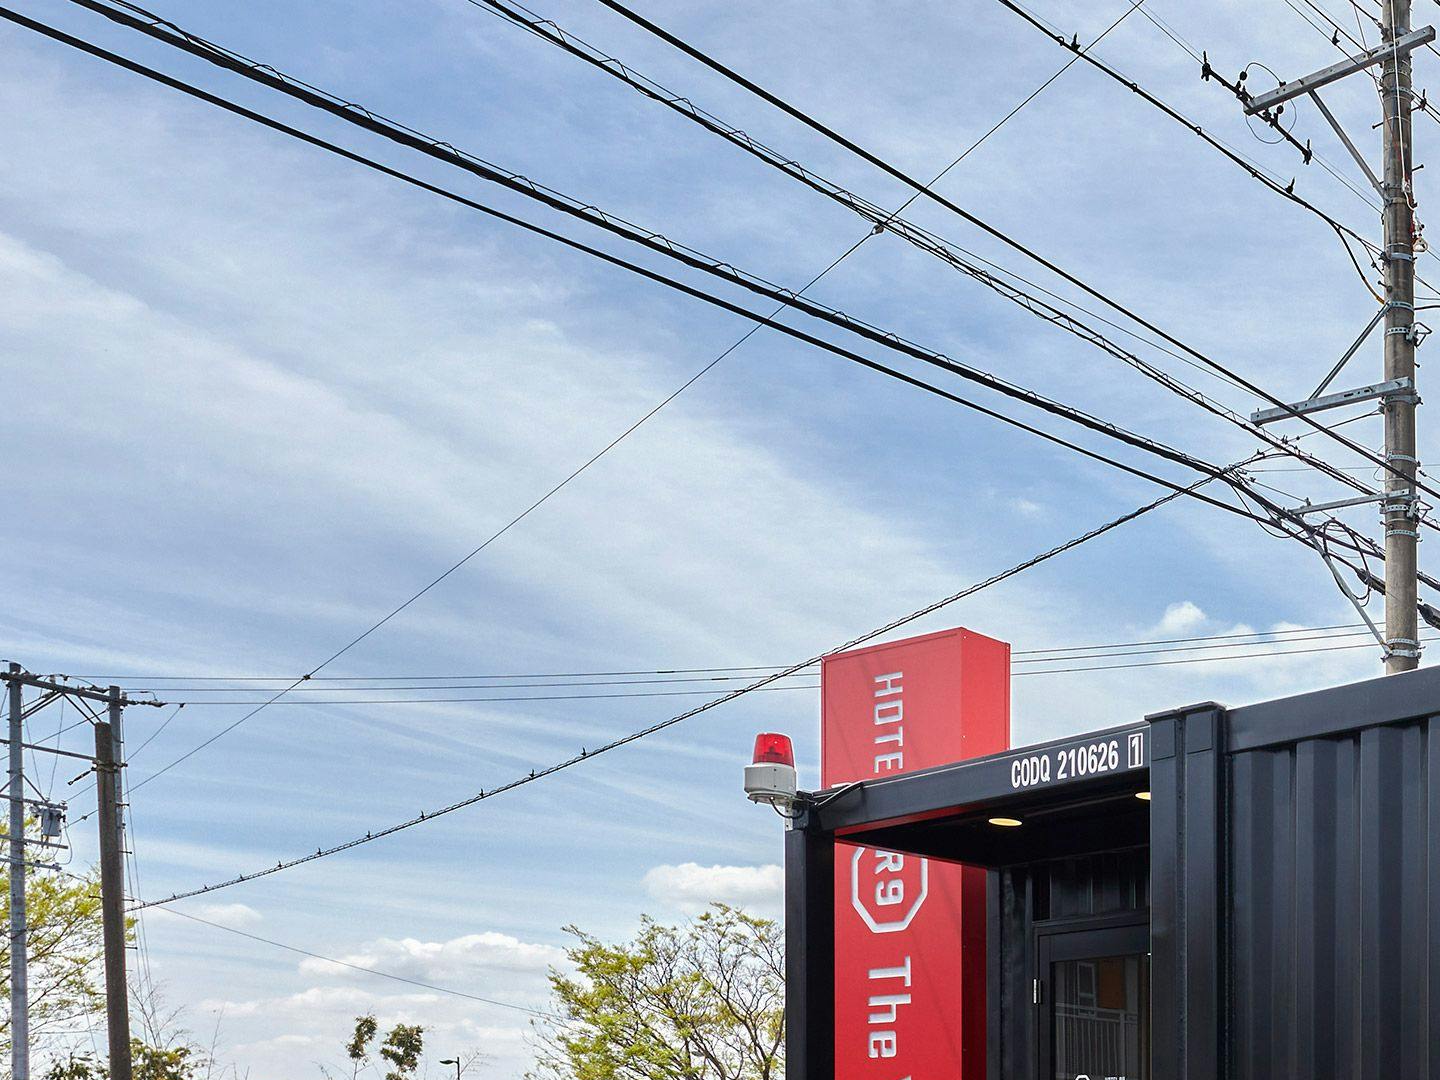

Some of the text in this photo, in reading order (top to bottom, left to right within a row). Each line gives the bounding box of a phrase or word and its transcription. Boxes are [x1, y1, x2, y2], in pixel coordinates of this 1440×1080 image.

[873, 671, 904, 774] HOTE
[1011, 754, 1051, 789] CODQ
[1057, 740, 1119, 780] 210626
[874, 849, 904, 906] R9
[867, 955, 912, 1059] The
